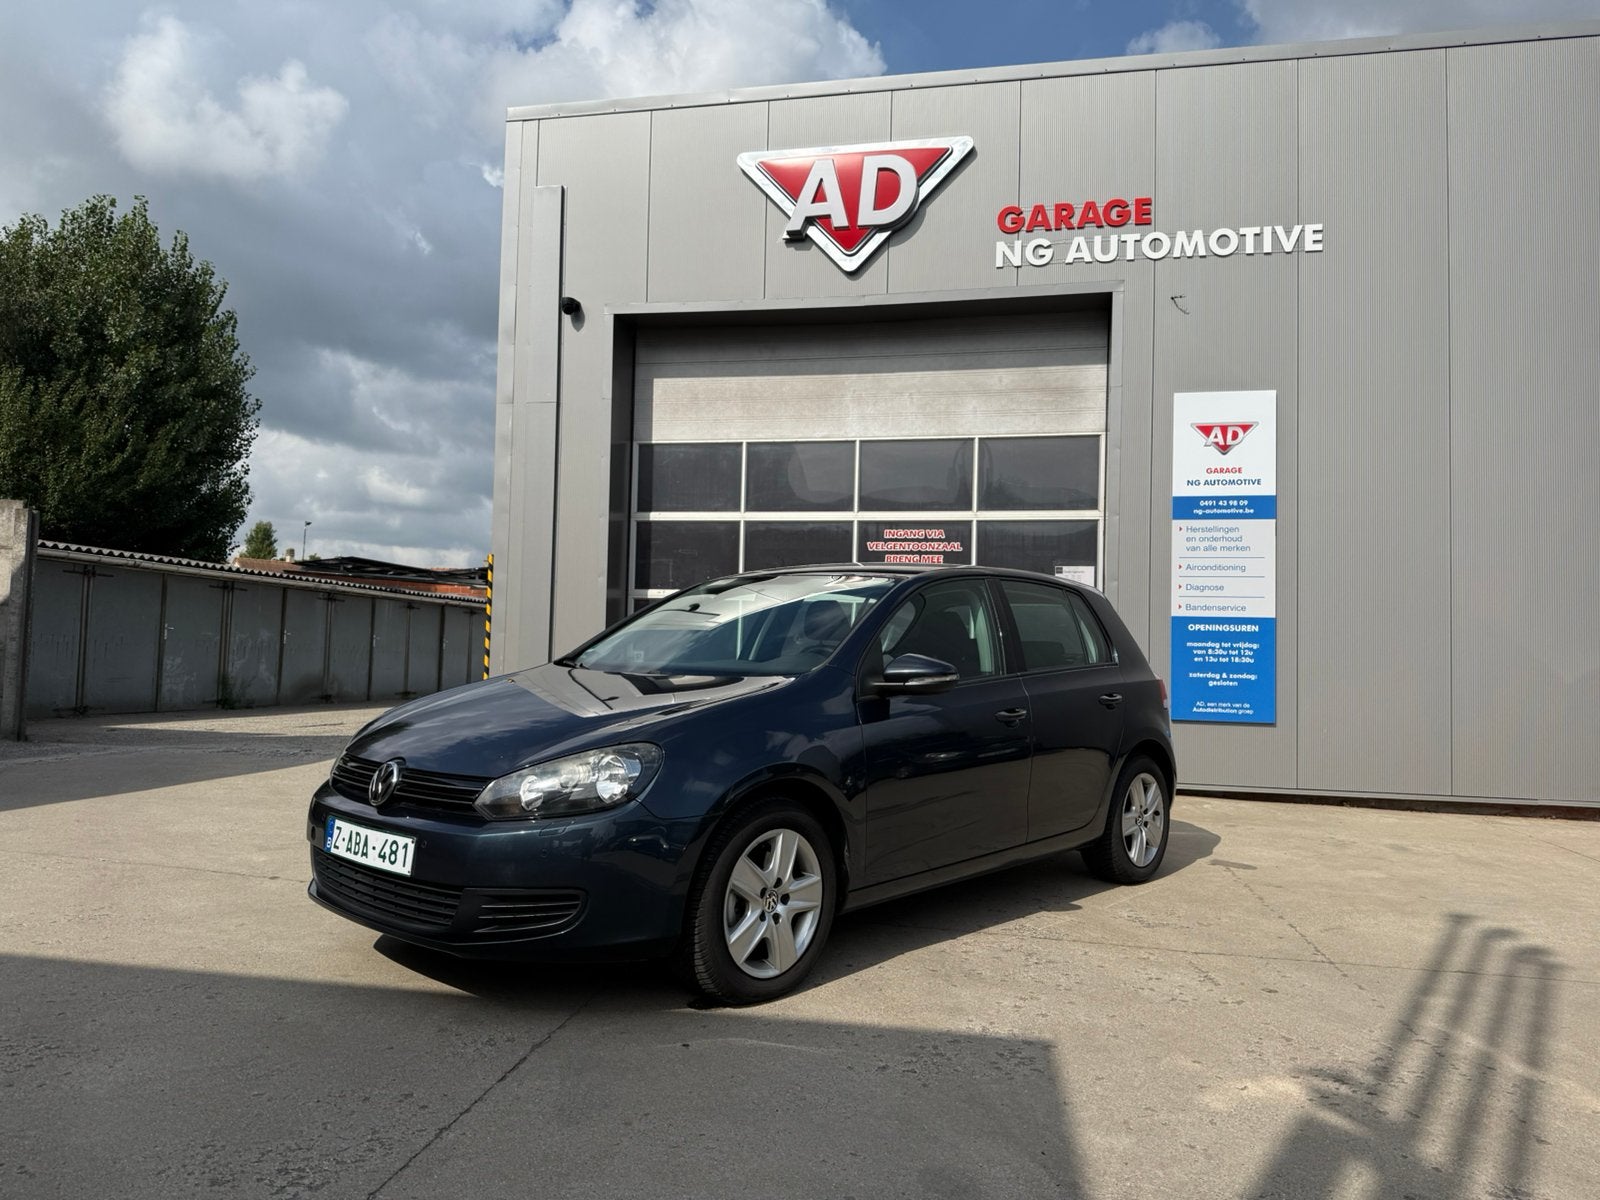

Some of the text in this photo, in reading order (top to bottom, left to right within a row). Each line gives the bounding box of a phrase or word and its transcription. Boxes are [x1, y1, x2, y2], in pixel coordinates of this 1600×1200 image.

[785, 153, 920, 240] AD
[996, 197, 1153, 234] GARAGE
[994, 223, 1325, 269] NG AUTOMOTIVE
[1204, 425, 1244, 447] AD
[1205, 467, 1243, 475] GARAGE
[1186, 478, 1262, 487] NG AUTOMOTIVE
[1193, 507, 1255, 515] ng-automotive.be
[884, 529, 945, 538] INGANG VIA
[1185, 526, 1240, 534] Herstellingen
[1198, 535, 1243, 543] onderhoud
[867, 541, 963, 551] VELGENTOONZAAL
[885, 554, 944, 564] BRENG MEE
[1185, 563, 1247, 572] Airconditioning
[1185, 584, 1225, 592] Diagnose
[1185, 604, 1247, 612] Bandenservice
[1187, 624, 1259, 632] OPENINGSUREN
[1186, 641, 1220, 649] maandag
[1189, 672, 1220, 680] zaterdag
